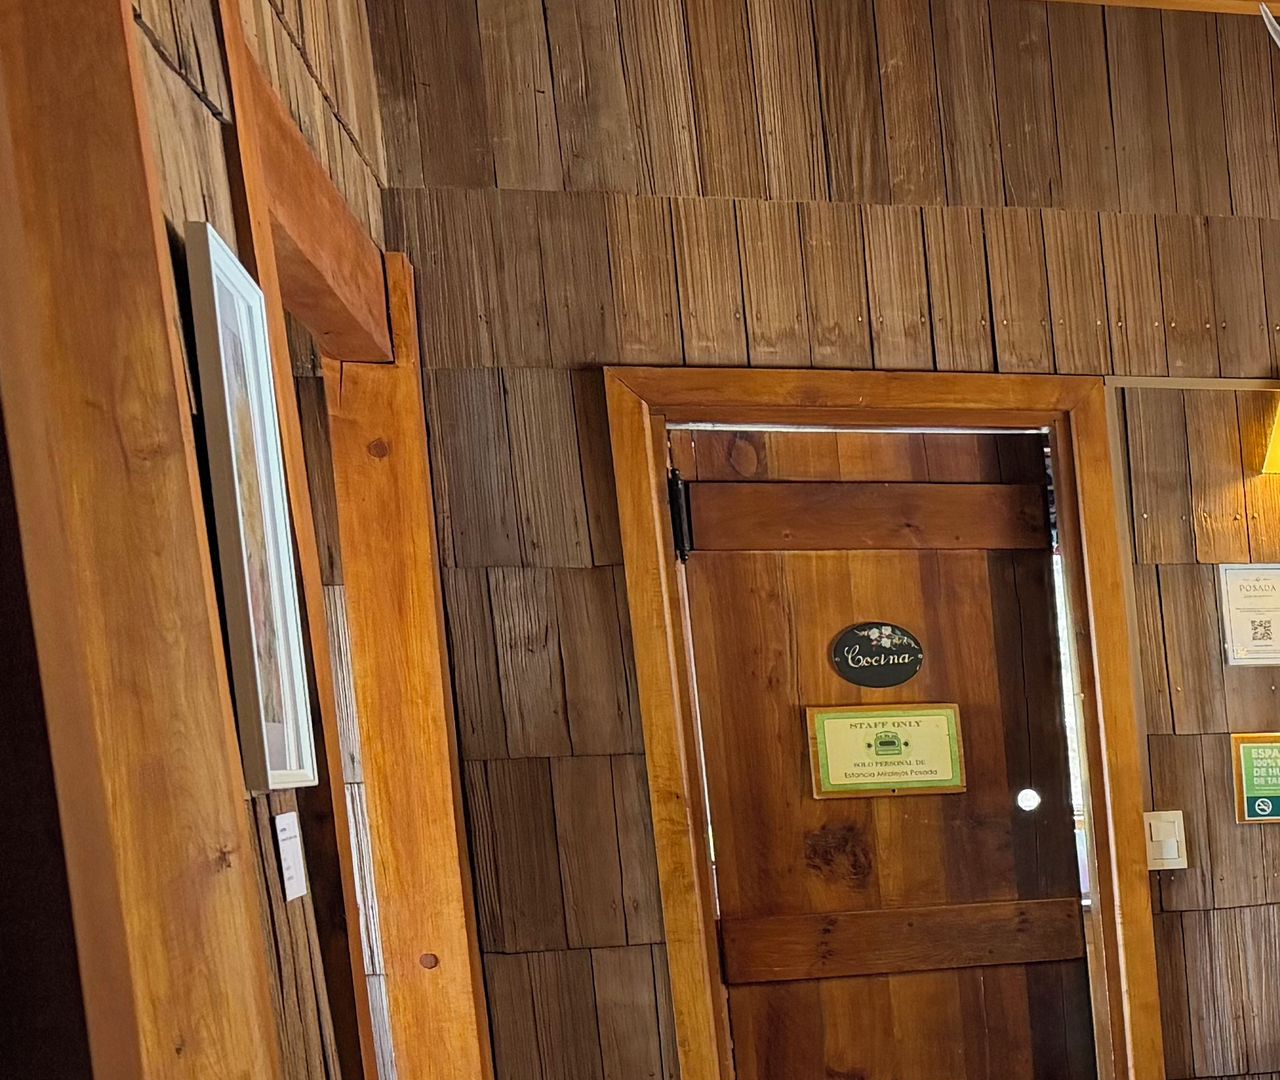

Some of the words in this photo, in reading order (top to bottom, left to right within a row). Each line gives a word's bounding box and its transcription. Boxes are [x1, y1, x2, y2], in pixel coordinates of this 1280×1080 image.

[1239, 584, 1278, 592] POSADA
[844, 644, 915, 668] Cocina
[849, 721, 889, 729] STAFF
[892, 720, 922, 728] ONLY
[875, 759, 912, 767] PERSONAL
[1253, 759, 1276, 767] 100%
[1253, 767, 1267, 776] DE
[1253, 776, 1266, 785] DE
